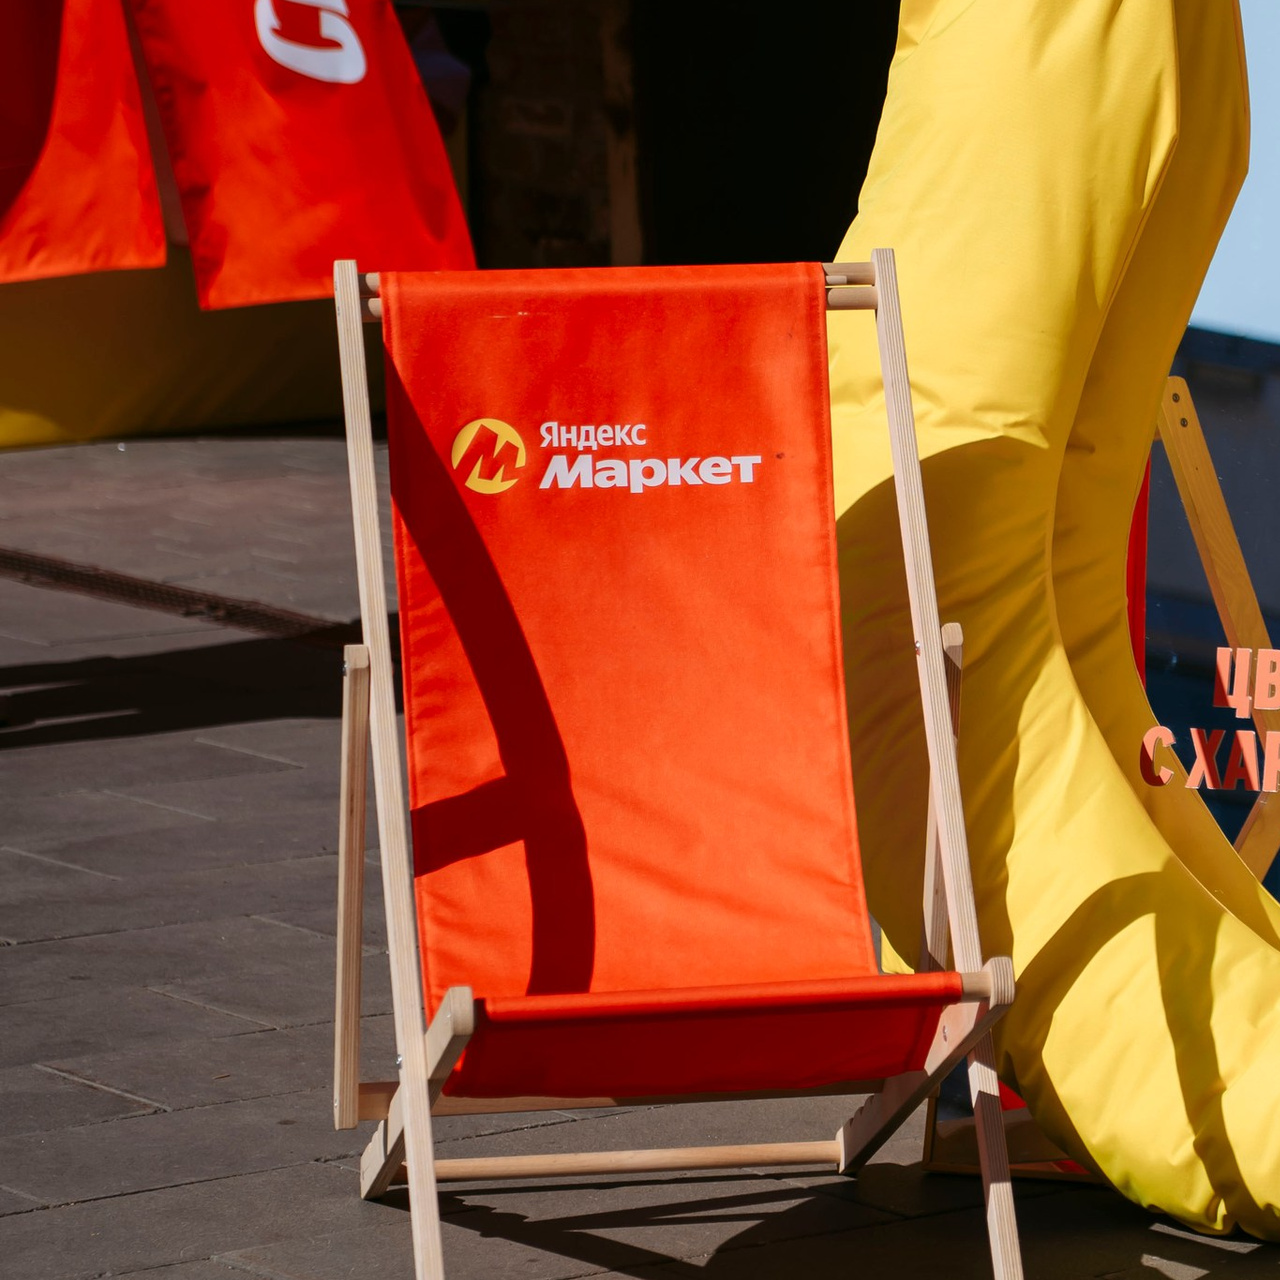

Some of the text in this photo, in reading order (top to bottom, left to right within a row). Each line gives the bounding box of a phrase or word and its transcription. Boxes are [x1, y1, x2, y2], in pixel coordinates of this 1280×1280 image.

[540, 422, 647, 450] Яндекс
[539, 454, 762, 493] Маркет
[1140, 725, 1176, 787] С
